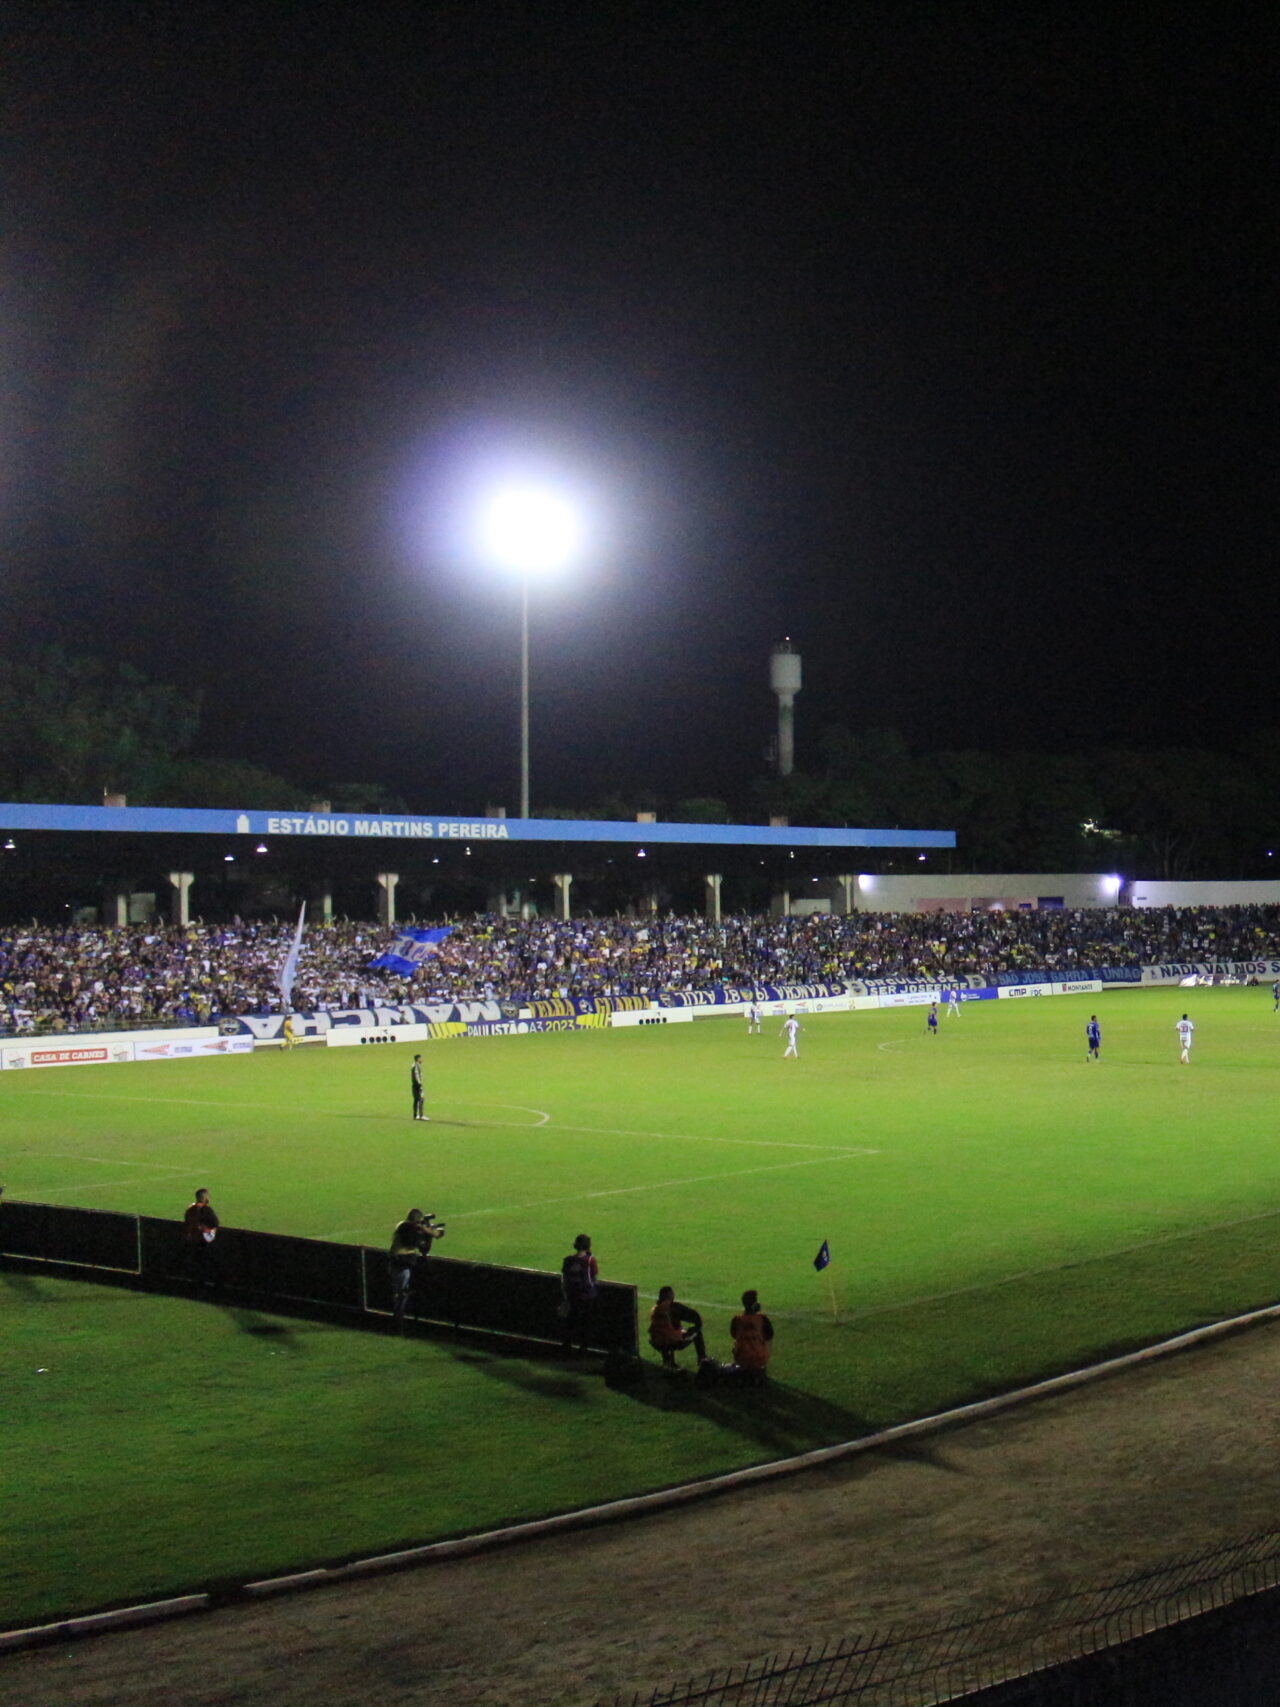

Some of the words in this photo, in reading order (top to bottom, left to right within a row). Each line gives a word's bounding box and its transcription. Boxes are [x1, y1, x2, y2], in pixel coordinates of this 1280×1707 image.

[267, 815, 349, 835] ESTÁDIO
[354, 820, 434, 837] MARTINS
[438, 823, 509, 839] PEREIRA
[1160, 964, 1201, 978] NADA
[1235, 961, 1267, 974] NOS
[772, 984, 829, 1001] MANCHA
[870, 985, 897, 996] SER
[900, 982, 968, 995] JOSEENSE
[674, 990, 716, 1007] AZUL
[545, 1020, 575, 1033] 2023
[33, 1053, 58, 1063] CASA
[59, 1052, 71, 1061] DE
[71, 1050, 105, 1061] CARNES
